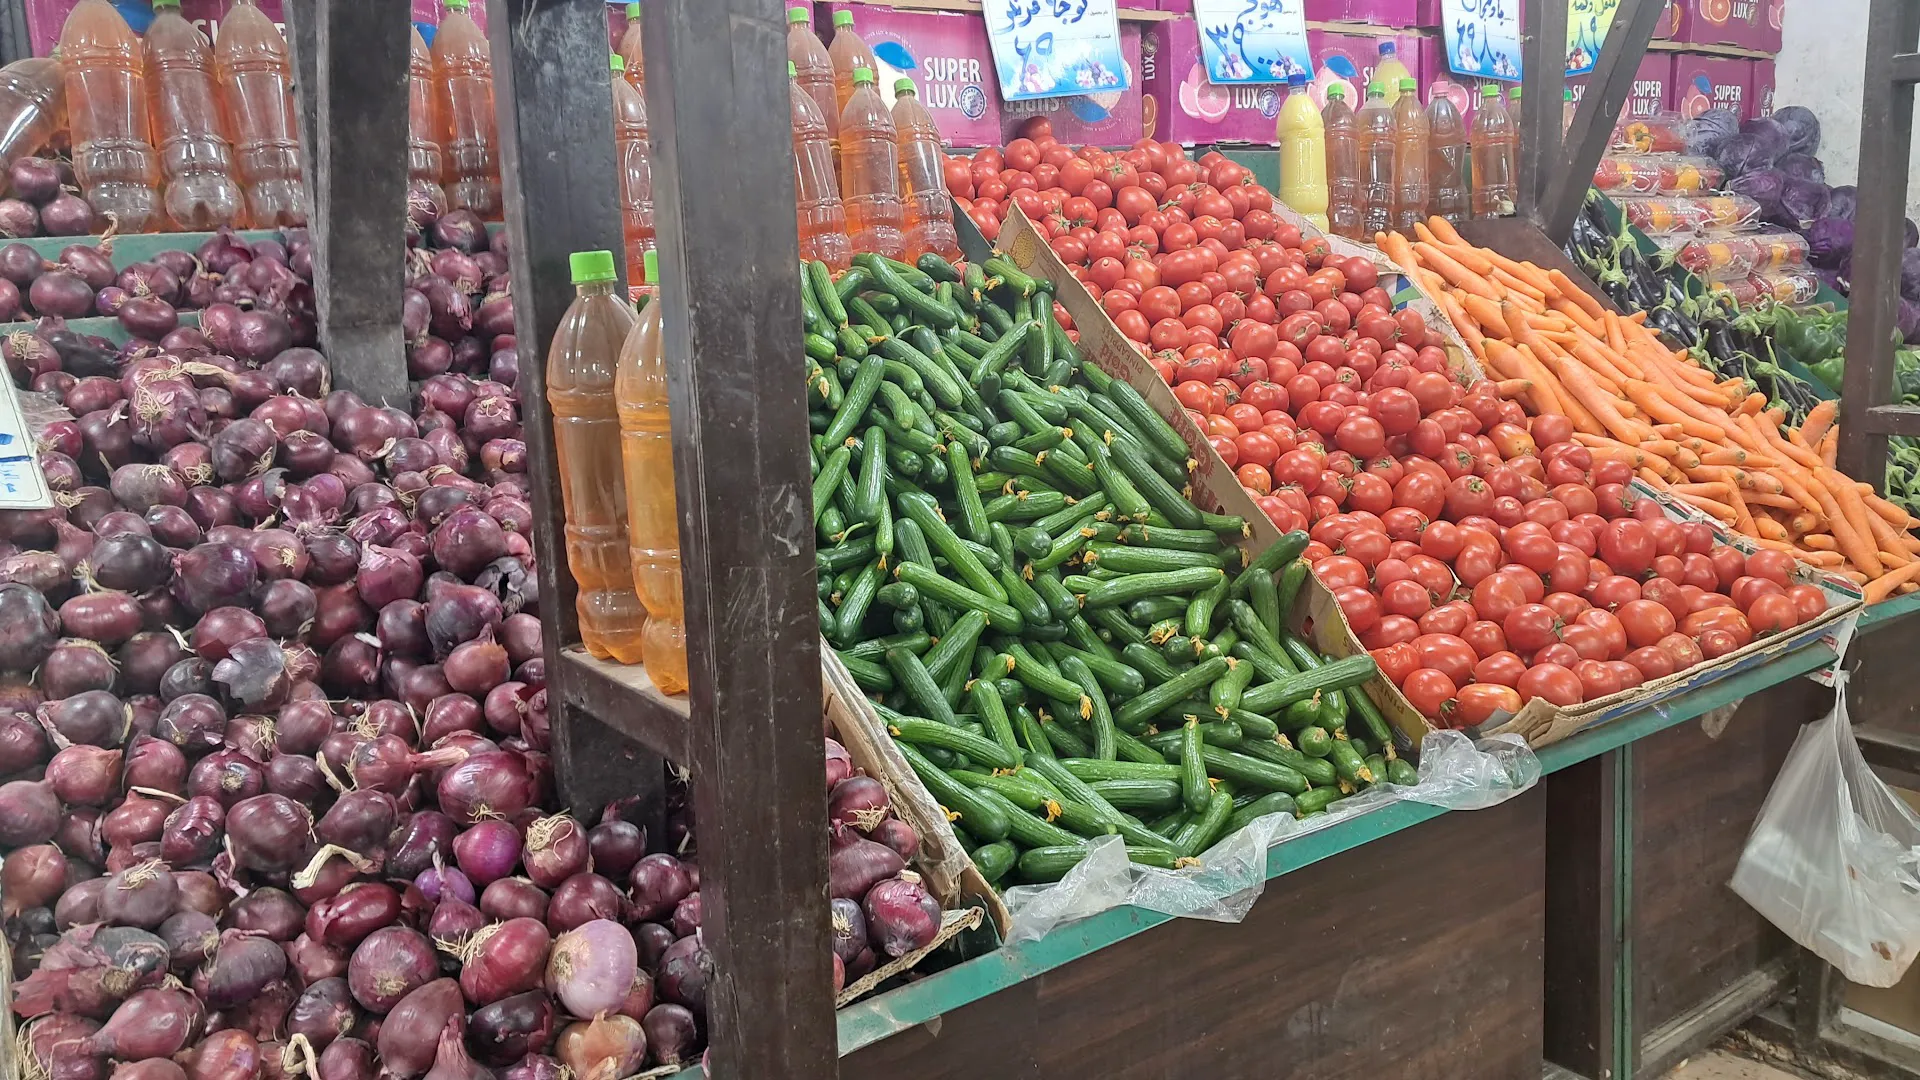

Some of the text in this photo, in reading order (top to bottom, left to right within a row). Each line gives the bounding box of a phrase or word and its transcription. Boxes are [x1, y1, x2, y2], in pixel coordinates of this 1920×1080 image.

[1732, 3, 1749, 19] LUX
[923, 57, 983, 83] SUPER
[1143, 54, 1156, 81] LUX
[925, 84, 961, 109] LUX
[1235, 88, 1260, 109] LUX
[1633, 80, 1662, 98] SUPER
[1713, 85, 1742, 101] SUPER
[1632, 99, 1649, 115] LUX
